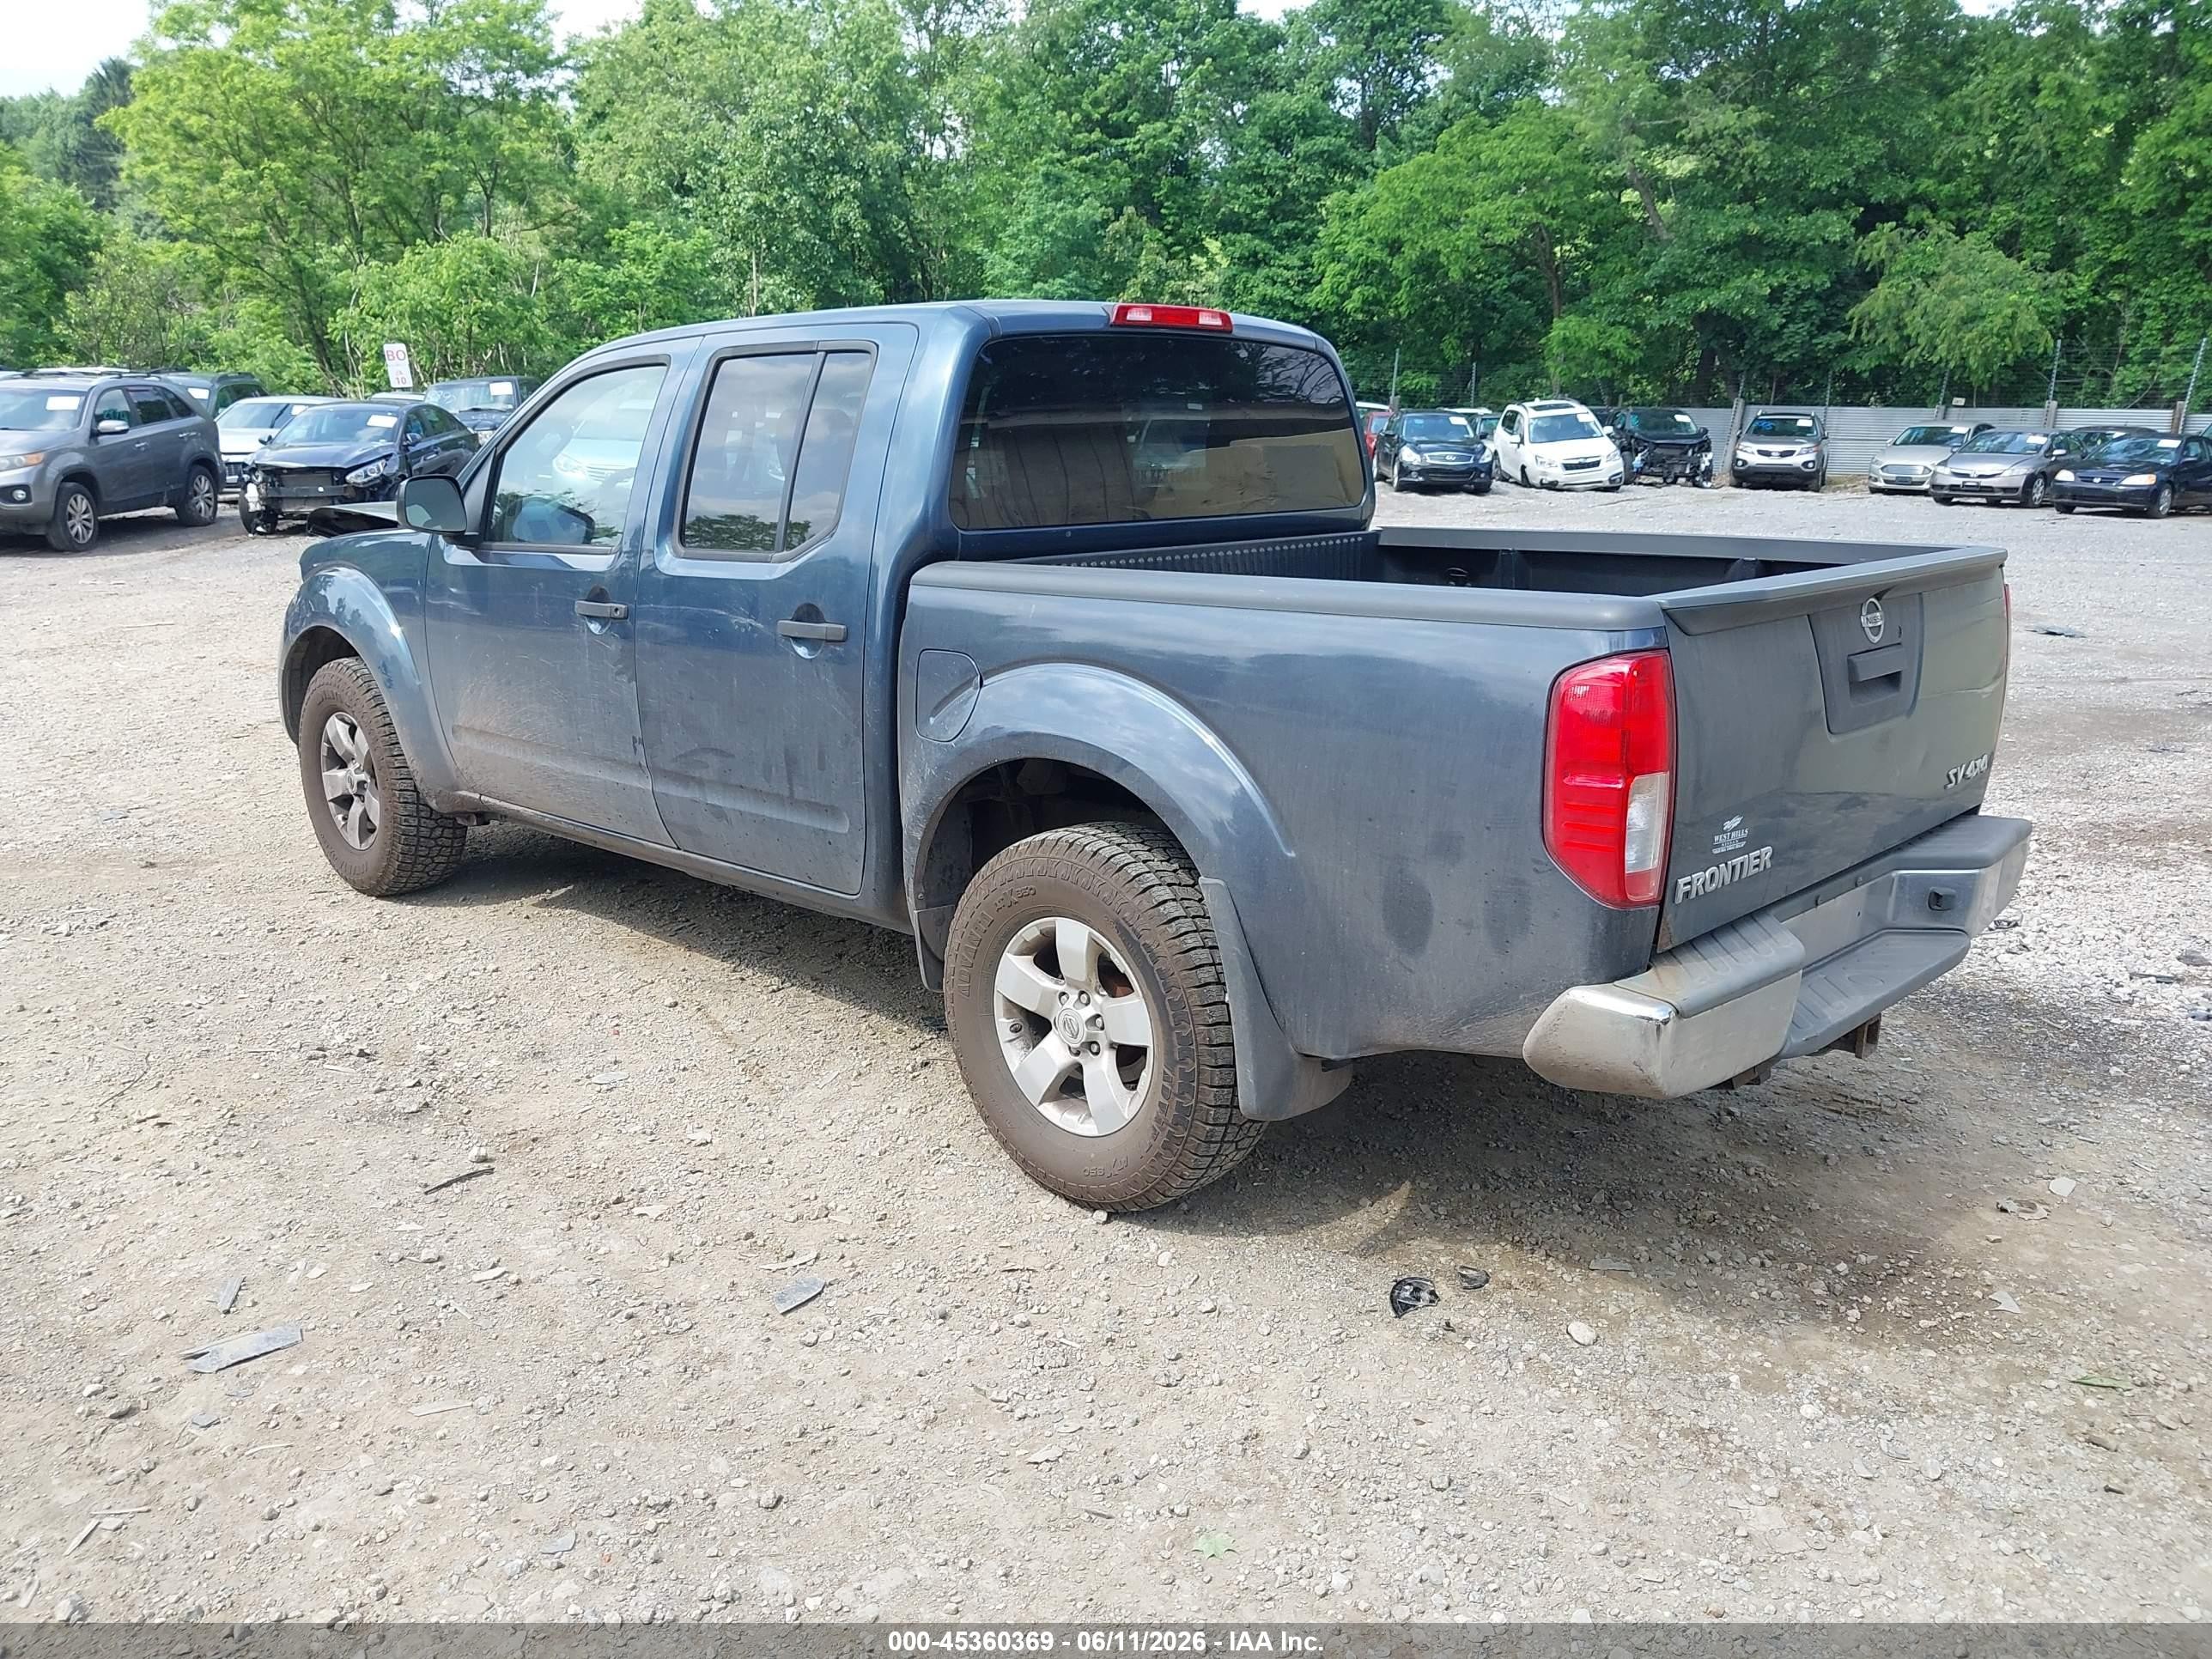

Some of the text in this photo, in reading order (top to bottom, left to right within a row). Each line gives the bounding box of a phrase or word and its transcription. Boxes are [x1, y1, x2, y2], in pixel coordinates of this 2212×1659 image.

[386, 349, 406, 361] BO
[396, 377, 407, 386] 10
[1945, 764, 1966, 788] SV
[1714, 828, 1749, 843] WEST HILLS
[1674, 846, 1773, 904] FRONTIER
